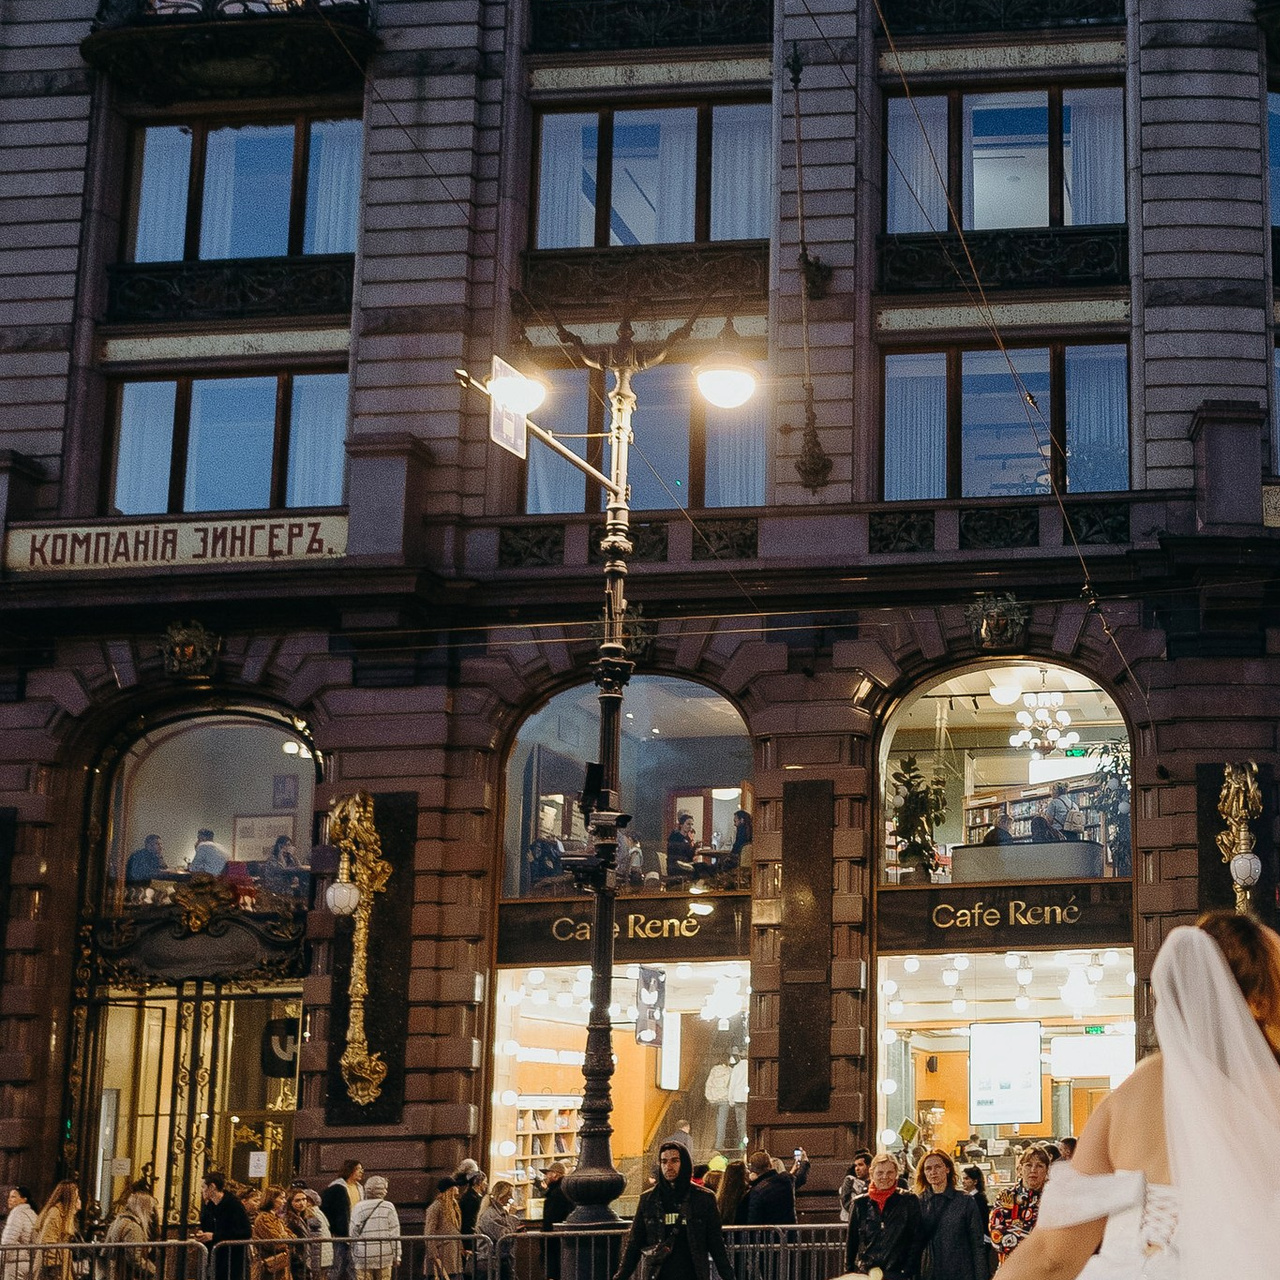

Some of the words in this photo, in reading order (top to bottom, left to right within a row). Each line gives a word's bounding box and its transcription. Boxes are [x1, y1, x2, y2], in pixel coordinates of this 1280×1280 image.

[932, 901, 1001, 929] Cafe
[1008, 895, 1082, 927] René
[552, 917, 620, 941] Ca
